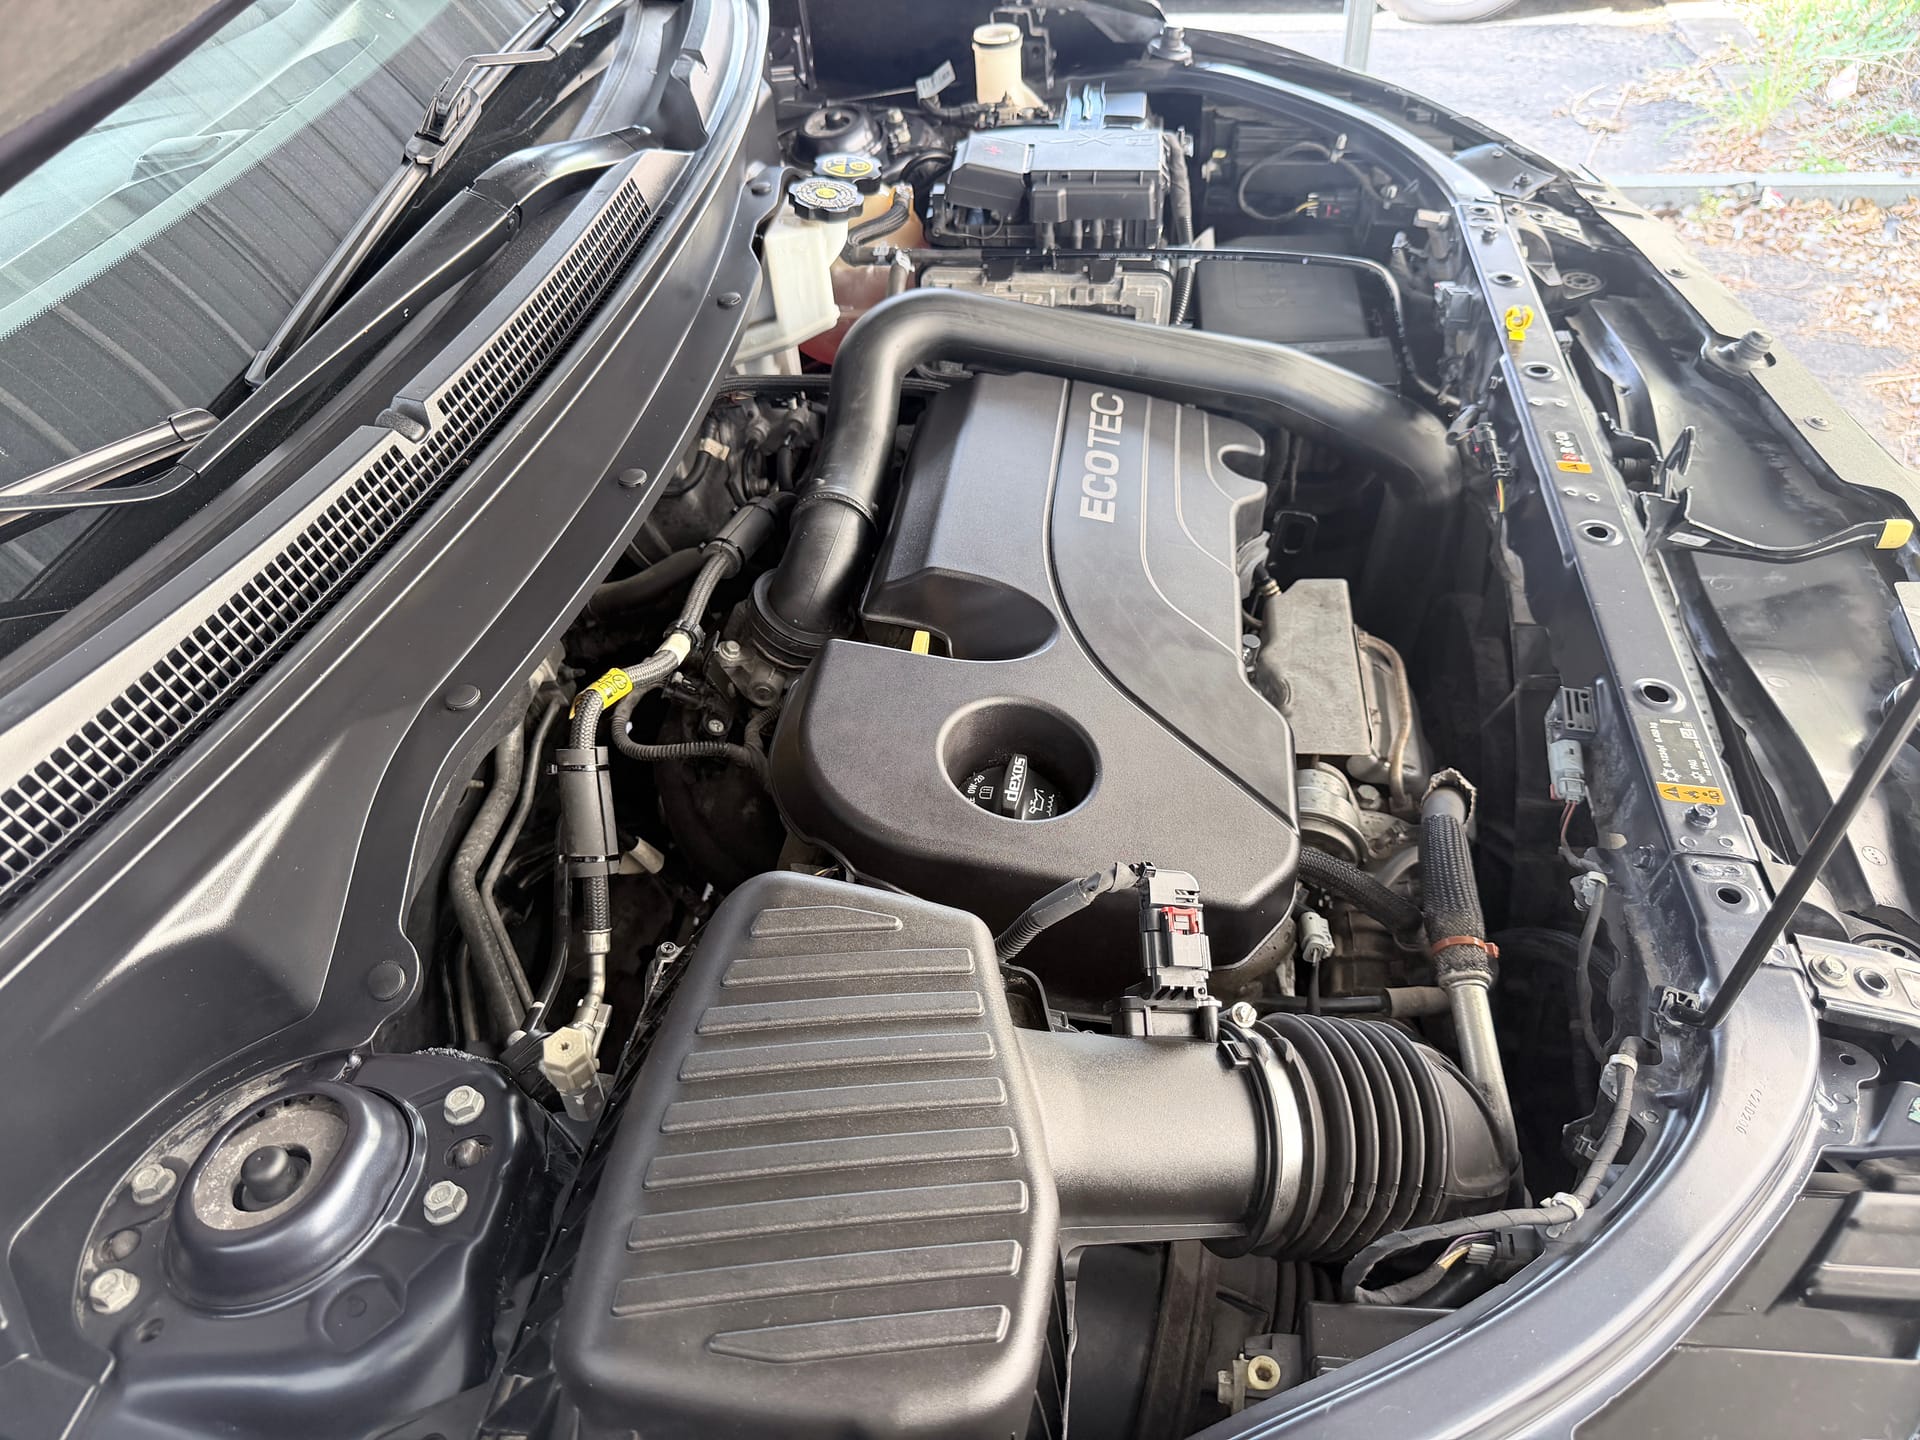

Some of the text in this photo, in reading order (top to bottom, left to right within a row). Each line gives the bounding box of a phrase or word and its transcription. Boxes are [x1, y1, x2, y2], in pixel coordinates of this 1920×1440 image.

[1080, 392, 1124, 523] ECOTEC
[967, 774, 985, 794] 0W-20
[1004, 755, 1026, 802] dexos
